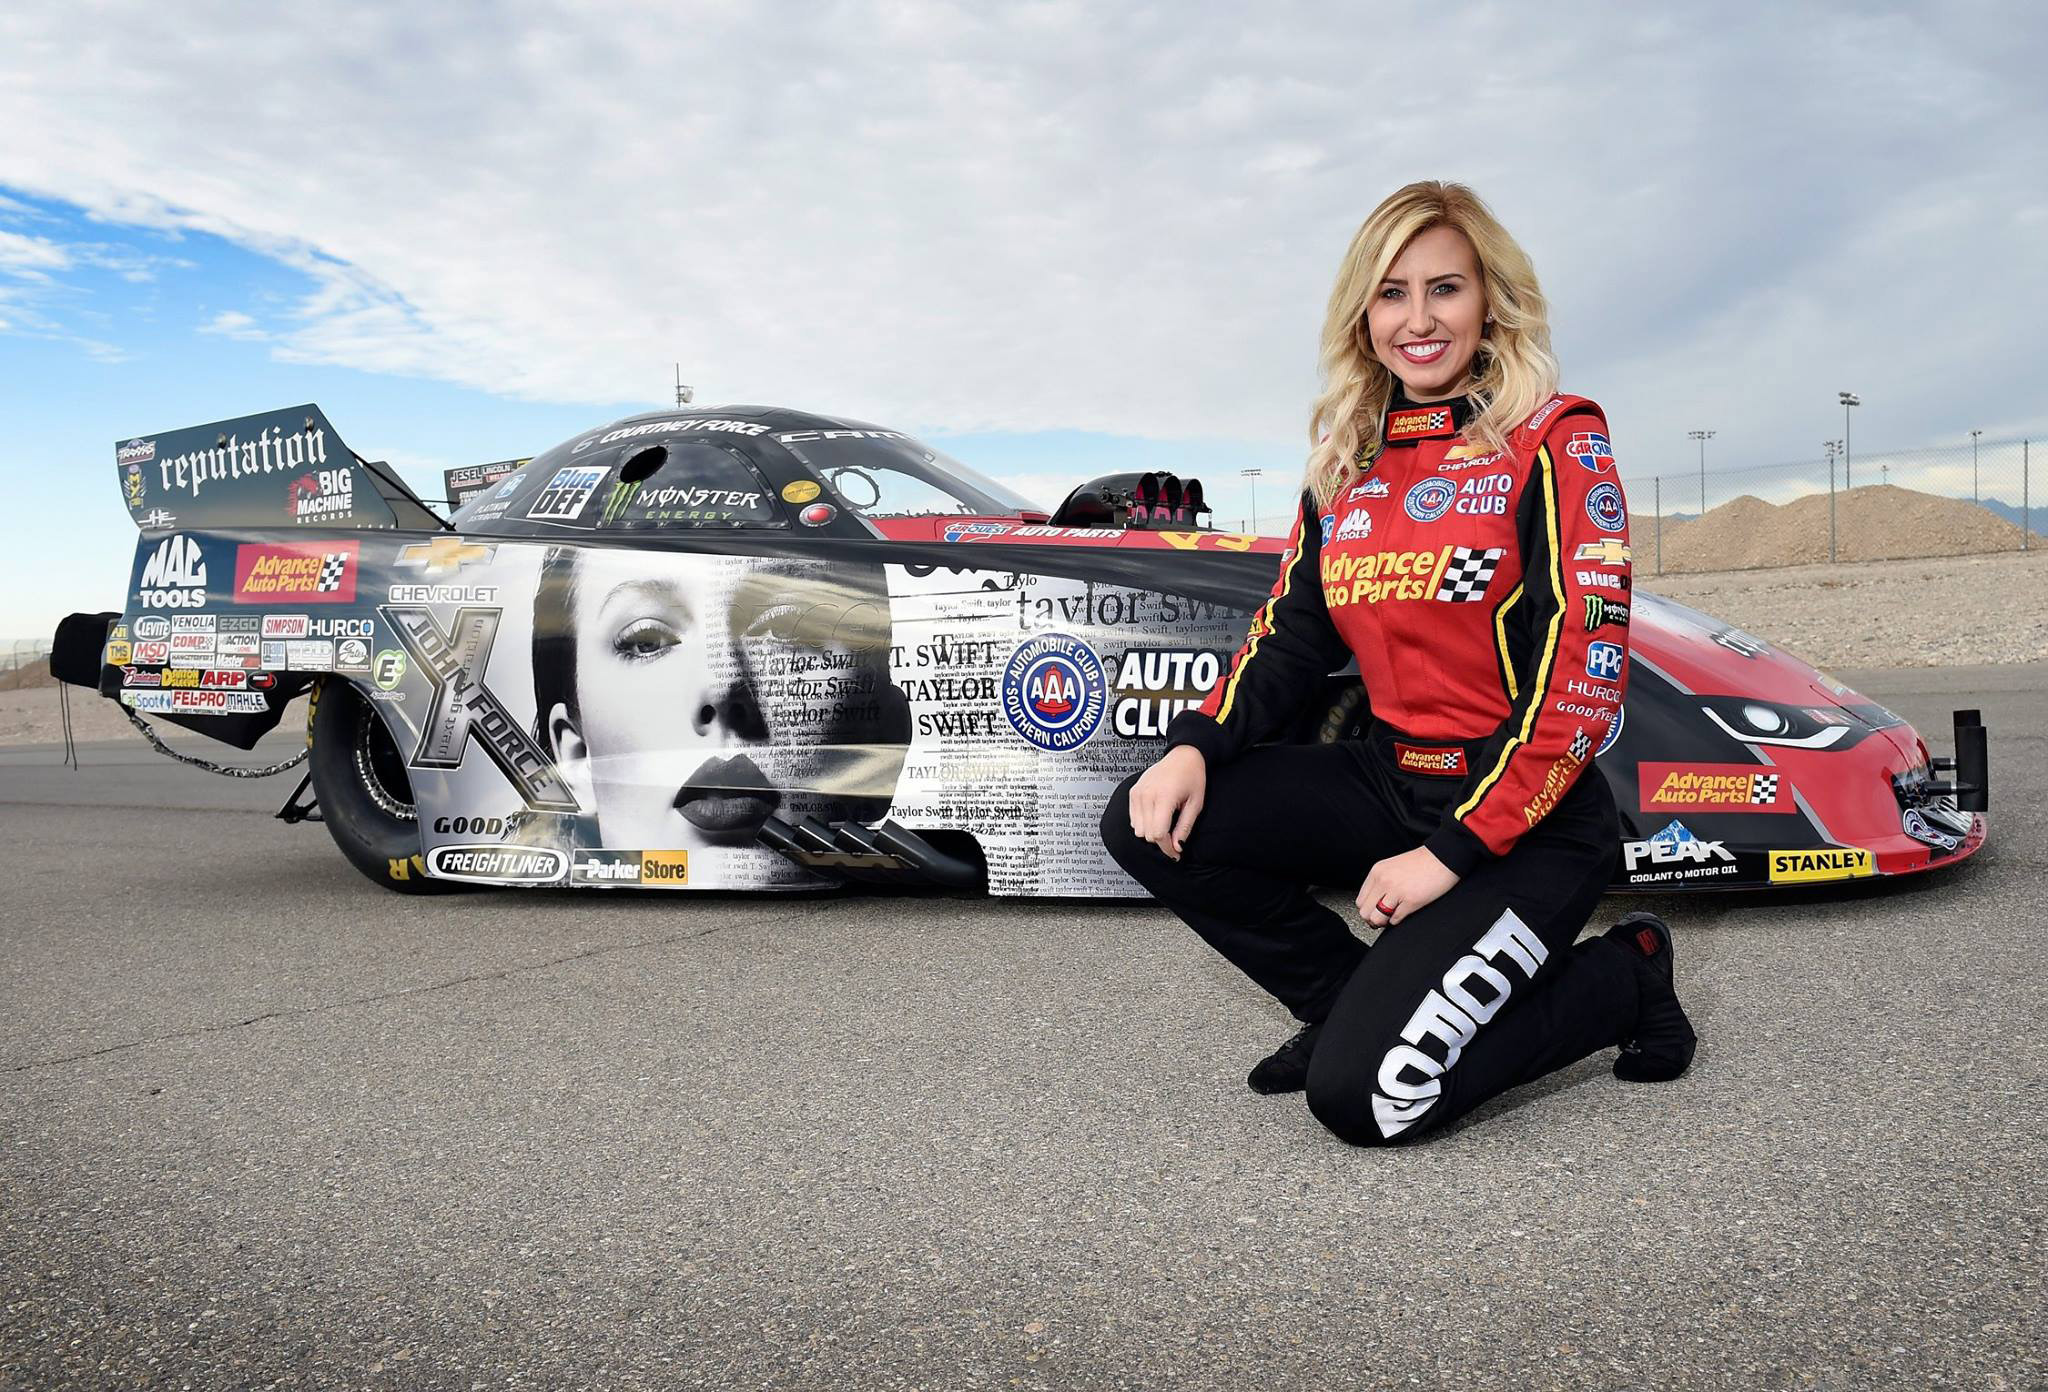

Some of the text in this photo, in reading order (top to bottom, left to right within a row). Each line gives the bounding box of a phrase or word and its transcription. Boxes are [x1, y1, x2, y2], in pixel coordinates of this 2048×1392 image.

[1394, 415, 1428, 427] Advance
[1530, 400, 1561, 429] SIMPSON
[600, 419, 771, 444] COURTNEY FORCE
[1390, 424, 1428, 435] Auto Parts
[1567, 441, 1613, 456] CARQU
[160, 426, 326, 497] reputation
[319, 467, 352, 496] BIG
[452, 470, 482, 482] JESEL
[549, 470, 600, 491] Blue
[1459, 473, 1514, 495] AUTO
[1347, 482, 1391, 501] PEAK
[1420, 493, 1444, 505] AAA
[297, 494, 352, 515] MACHINE
[531, 490, 586, 515] DEF
[1455, 495, 1508, 515] CLUB
[1599, 500, 1617, 512] AAA
[296, 511, 352, 524] RECORDS
[644, 511, 734, 521] ENERGY
[1337, 508, 1372, 535] MAC
[1010, 527, 1126, 539] AUTO PARTS
[1335, 530, 1369, 543] TOOLS
[141, 535, 207, 587] MAC
[251, 555, 318, 576] Advance
[1322, 550, 1436, 583] Advance
[242, 575, 315, 593] Auto Parts
[390, 586, 498, 602] CHEVROLET
[1325, 574, 1426, 609] uto Parts
[140, 589, 206, 608] TOOLS
[173, 617, 215, 628] VENOLIA
[265, 618, 305, 634] SIMPSON
[309, 619, 374, 636] HURCO
[1142, 624, 1172, 635] Swift,
[1175, 623, 1229, 635] taylorswift
[135, 643, 167, 658] MSD
[173, 636, 205, 648] COMP
[1103, 637, 1193, 649] swift taylor swift
[890, 642, 998, 668] T. SWIFT
[1009, 637, 1077, 681] AUTOMOBILE
[1074, 648, 1100, 681] CLUB
[1590, 646, 1622, 677] PPG
[202, 671, 245, 686] ARP
[1116, 652, 1220, 692] AUTO
[173, 691, 226, 707] FEL-PRO
[900, 676, 998, 702] TAYLOR
[1030, 674, 1076, 704] AAA
[1567, 679, 1622, 703] HURCO
[227, 693, 263, 706] MAHLE
[407, 619, 554, 793] JOHN FORCE
[918, 712, 997, 737] SWIFT
[1006, 686, 1102, 747] SOUTHERN CALIFORNIA
[1115, 697, 1205, 737] CLU
[1404, 750, 1442, 762] Advance
[1418, 760, 1441, 769] Parts
[907, 766, 962, 780] TAYLOR
[1550, 762, 1577, 802] Parts
[1660, 771, 1747, 790] Advance
[1523, 757, 1569, 827] Advance
[1650, 788, 1746, 804] Auto Parts
[890, 804, 1023, 821] Taylor Swift Taylor Swift
[441, 852, 556, 875] FREIGHTLINER
[1623, 840, 1737, 871] PEAK
[1775, 851, 1866, 874] STANLEY
[586, 858, 686, 879] Parker Store
[1630, 865, 1739, 883] COOLANT MOTOR OIL
[1371, 907, 1549, 1139] FORCE
